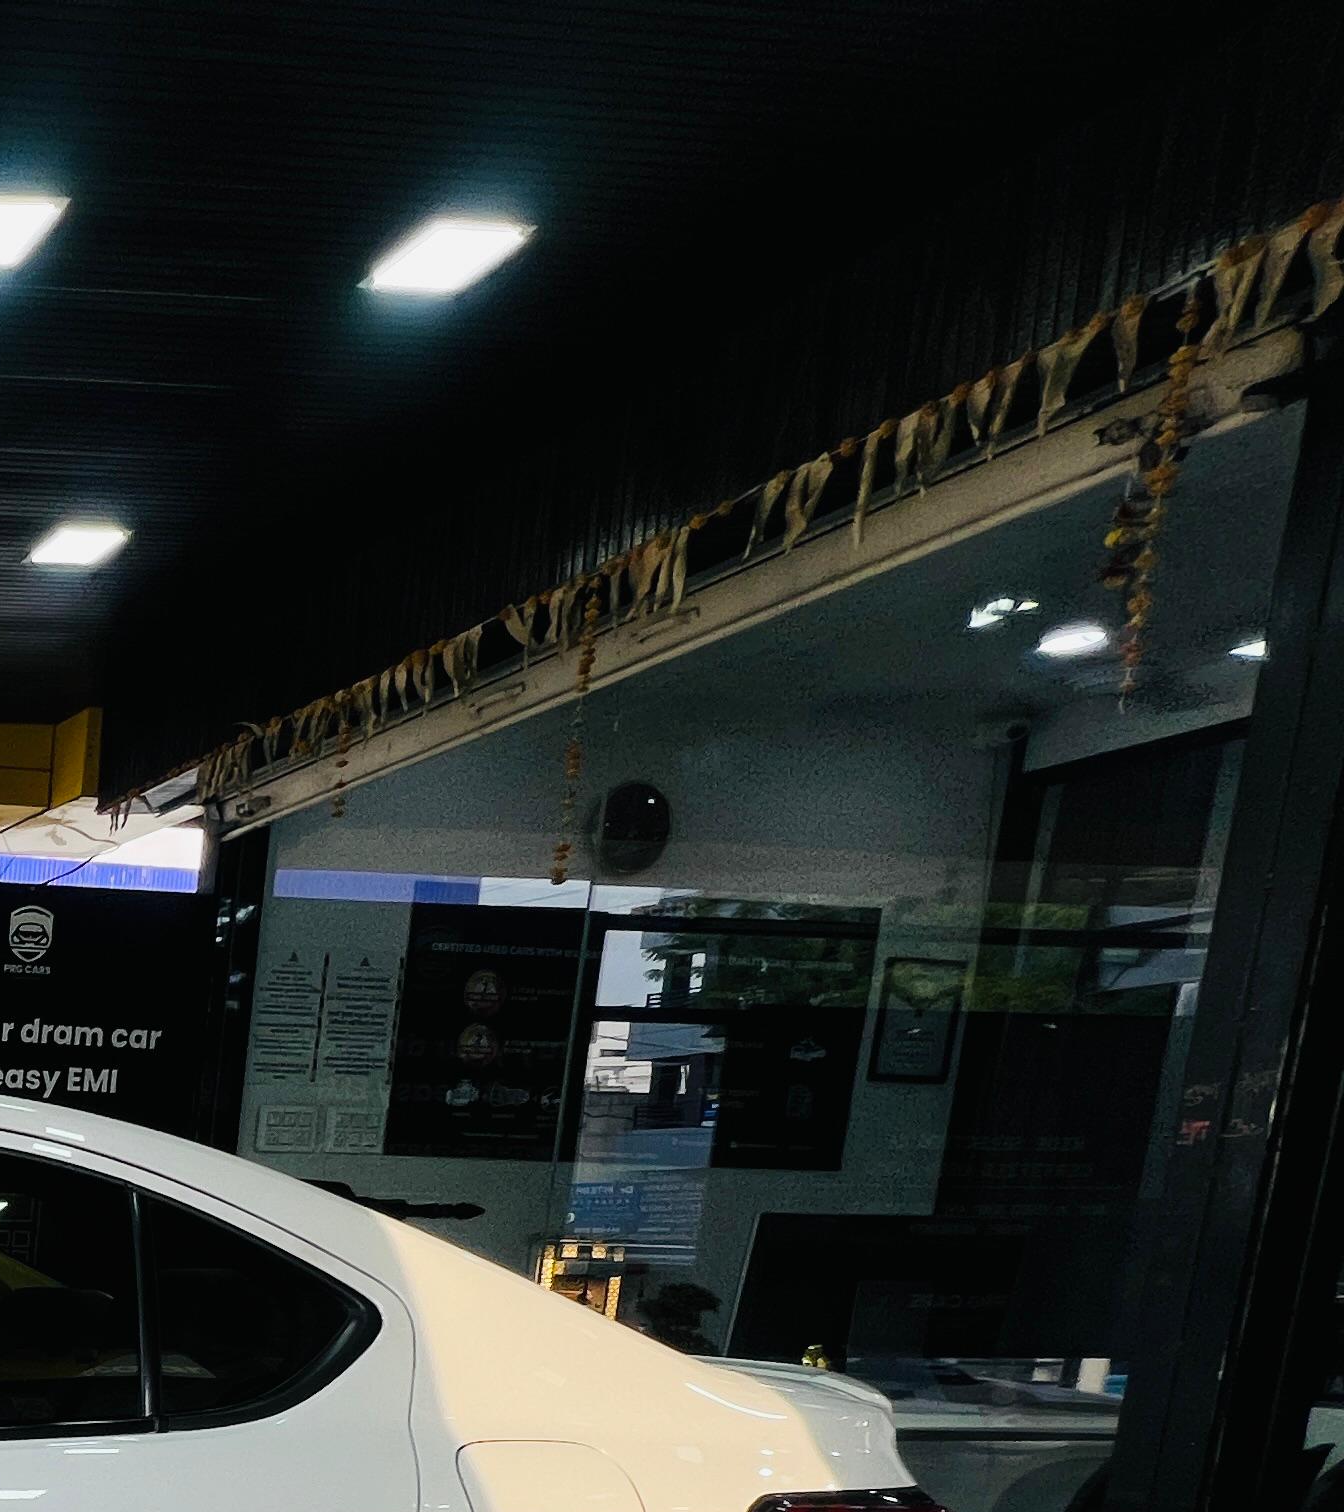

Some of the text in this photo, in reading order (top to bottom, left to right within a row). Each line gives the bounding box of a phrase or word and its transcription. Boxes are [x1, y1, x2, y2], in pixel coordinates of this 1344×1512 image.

[20, 1017, 104, 1048] dram
[111, 1025, 163, 1051] car
[66, 1067, 118, 1095] EMI
